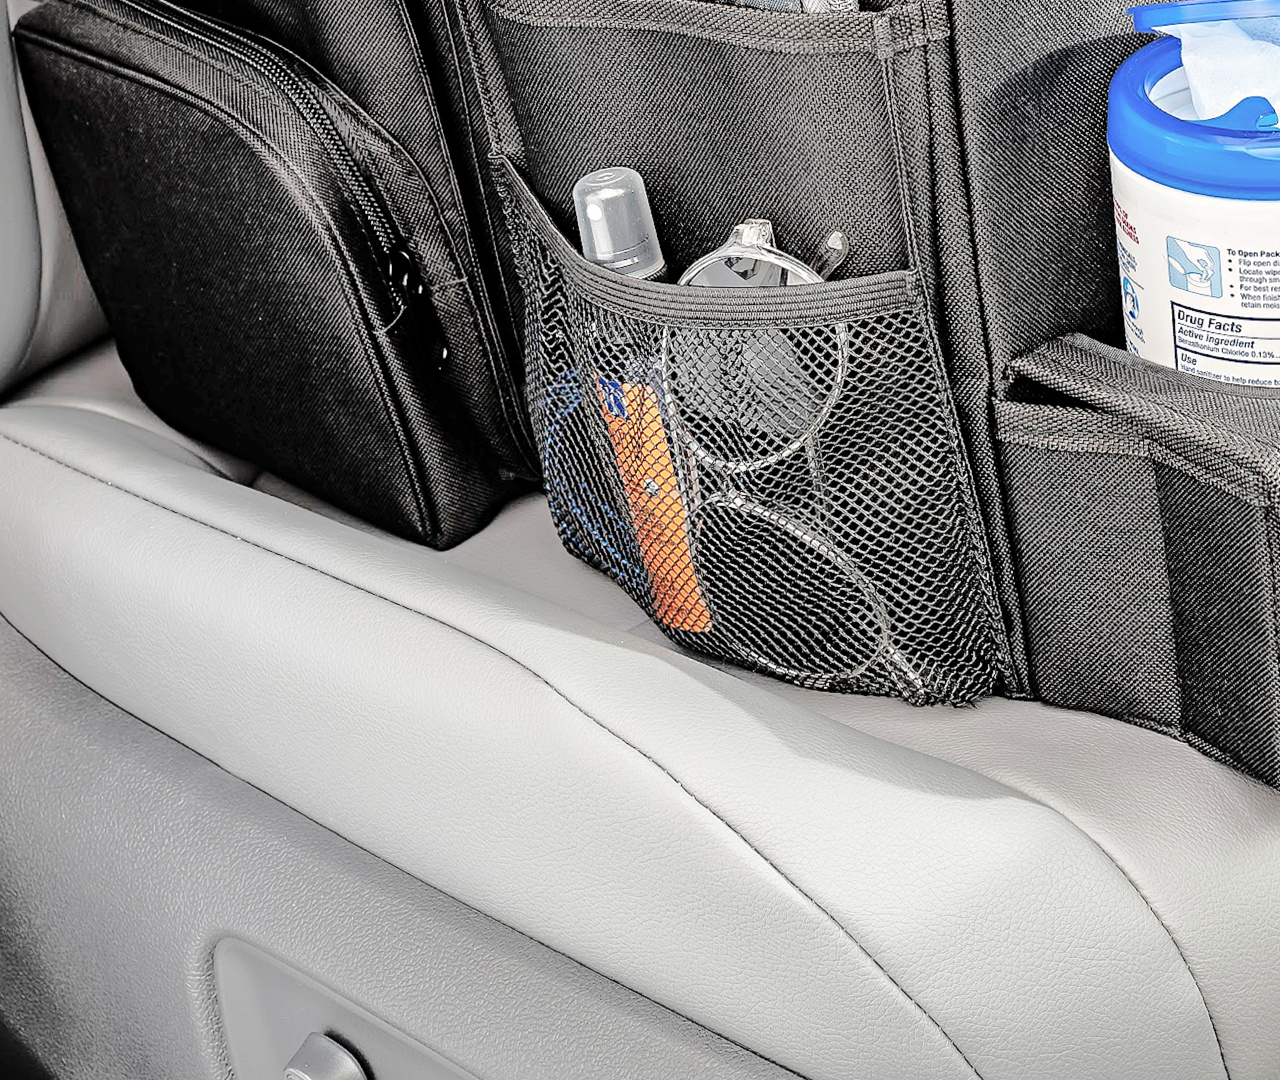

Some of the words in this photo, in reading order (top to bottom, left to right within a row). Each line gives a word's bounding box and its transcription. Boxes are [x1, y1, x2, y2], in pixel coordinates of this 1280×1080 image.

[1226, 248, 1236, 256] To
[1238, 249, 1258, 258] Open
[1239, 267, 1263, 276] Locate
[1239, 276, 1267, 284] through
[1240, 292, 1261, 301] When
[1177, 309, 1204, 328] Drug
[1207, 317, 1242, 333] Facts
[1177, 326, 1203, 341] Active
[1221, 347, 1249, 358] Chloride
[1251, 350, 1275, 358] 0.13%
[1181, 352, 1197, 365] Use
[1223, 374, 1231, 382] to
[1232, 375, 1247, 384] help
[1248, 378, 1272, 386] reduce
